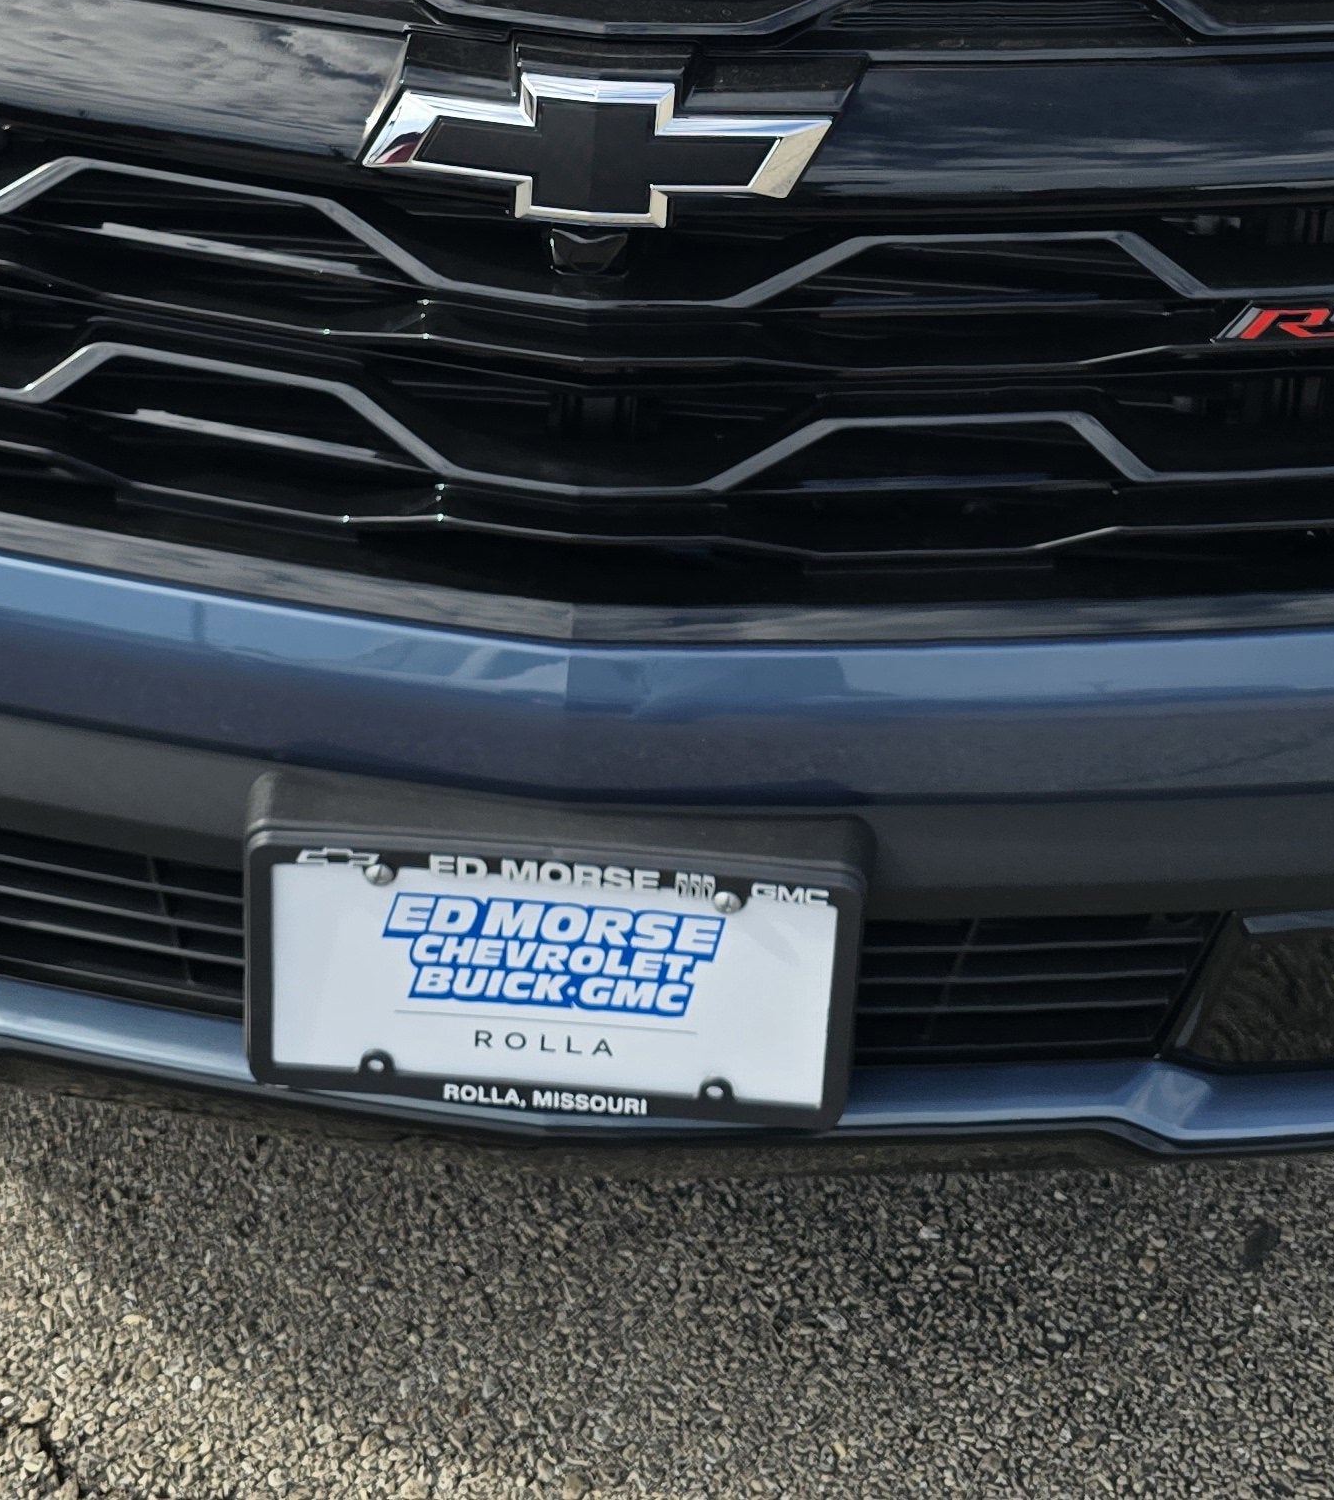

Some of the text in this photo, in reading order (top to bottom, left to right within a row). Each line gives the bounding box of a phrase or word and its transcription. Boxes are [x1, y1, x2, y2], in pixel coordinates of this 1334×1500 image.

[428, 853, 830, 907] ED MORSE GMC
[386, 893, 722, 955] ED MORSE
[474, 1029, 613, 1057] ROLLA
[442, 1082, 648, 1116] ROLLA, MISSOURI
